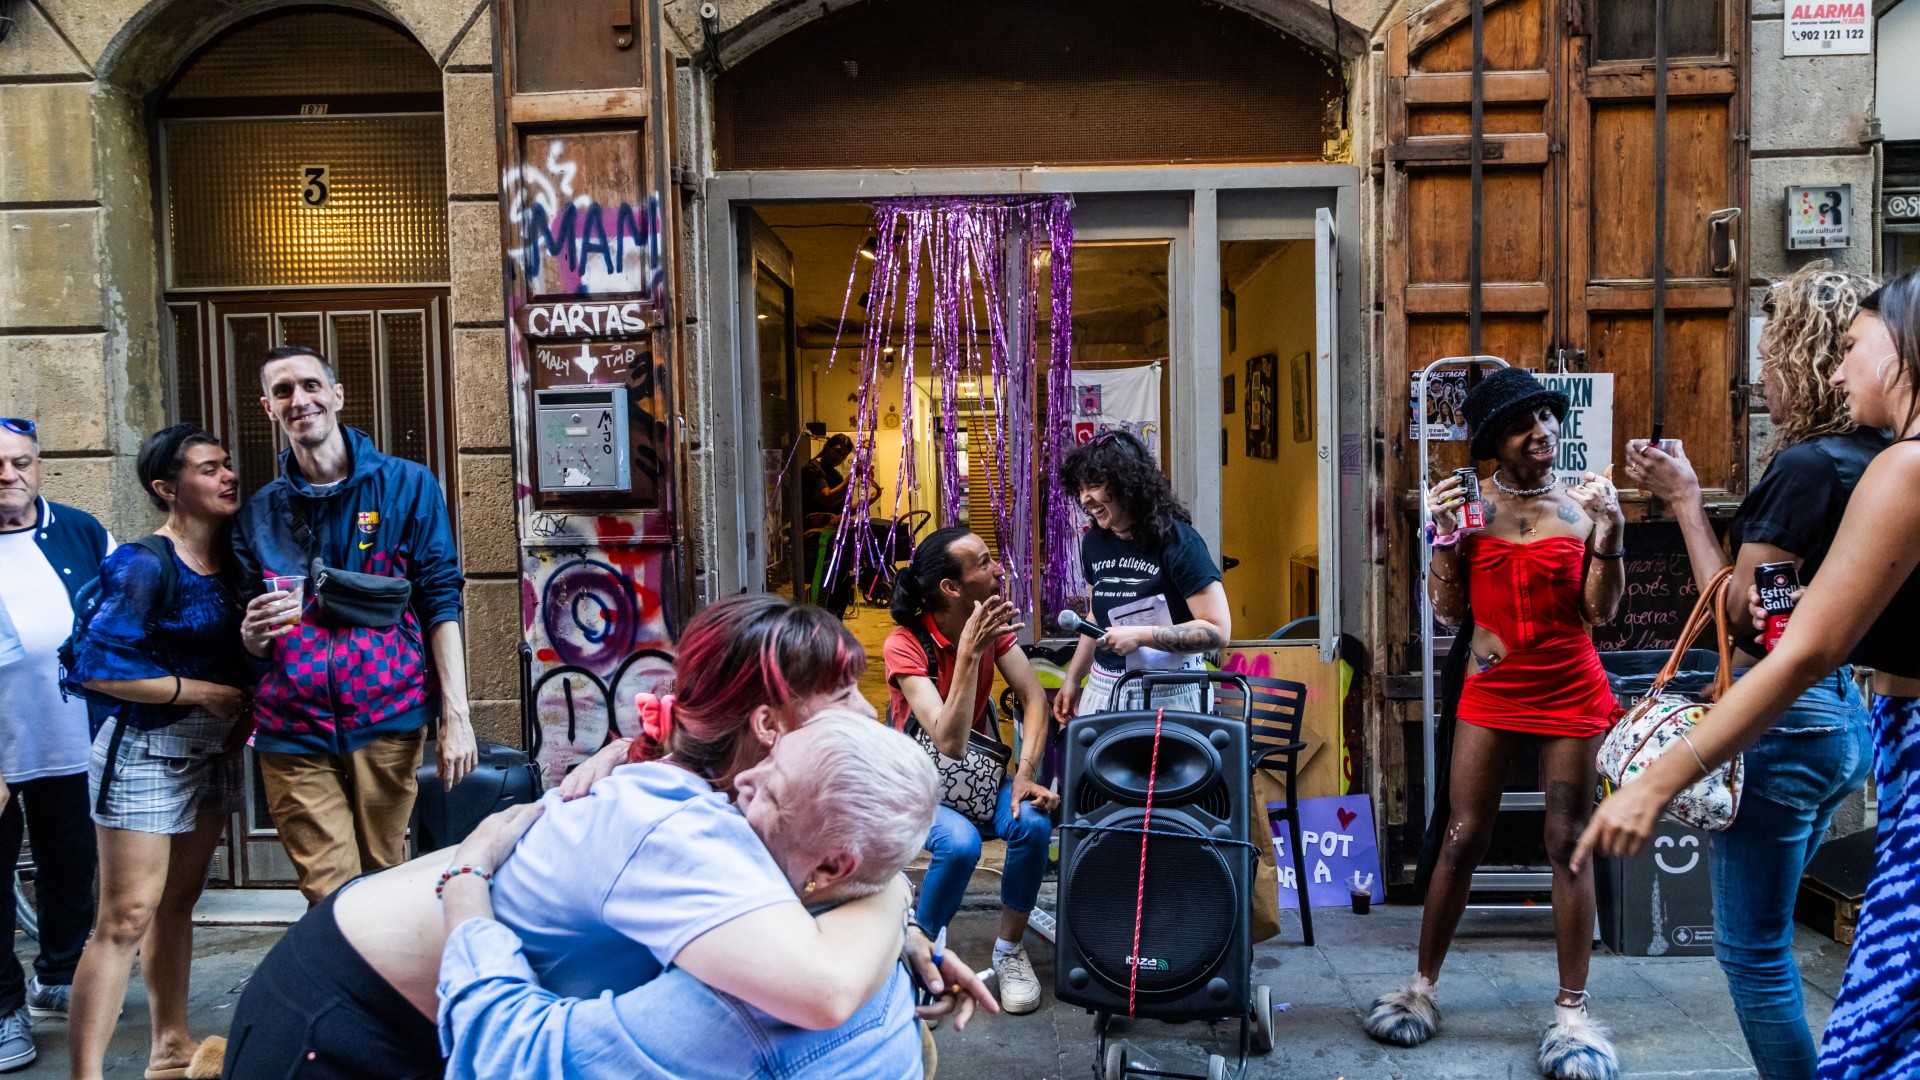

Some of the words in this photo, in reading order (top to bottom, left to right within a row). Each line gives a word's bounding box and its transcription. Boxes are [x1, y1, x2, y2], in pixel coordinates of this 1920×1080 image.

[1791, 3, 1865, 19] ALARMA
[1801, 31, 1819, 40] 902
[1824, 30, 1841, 39] 121
[1846, 29, 1864, 39] 122
[304, 167, 327, 206] 3
[528, 303, 646, 337] CARTAS
[1761, 585, 1797, 599] Estrell
[1302, 830, 1354, 857] POT
[1313, 858, 1332, 884] A
